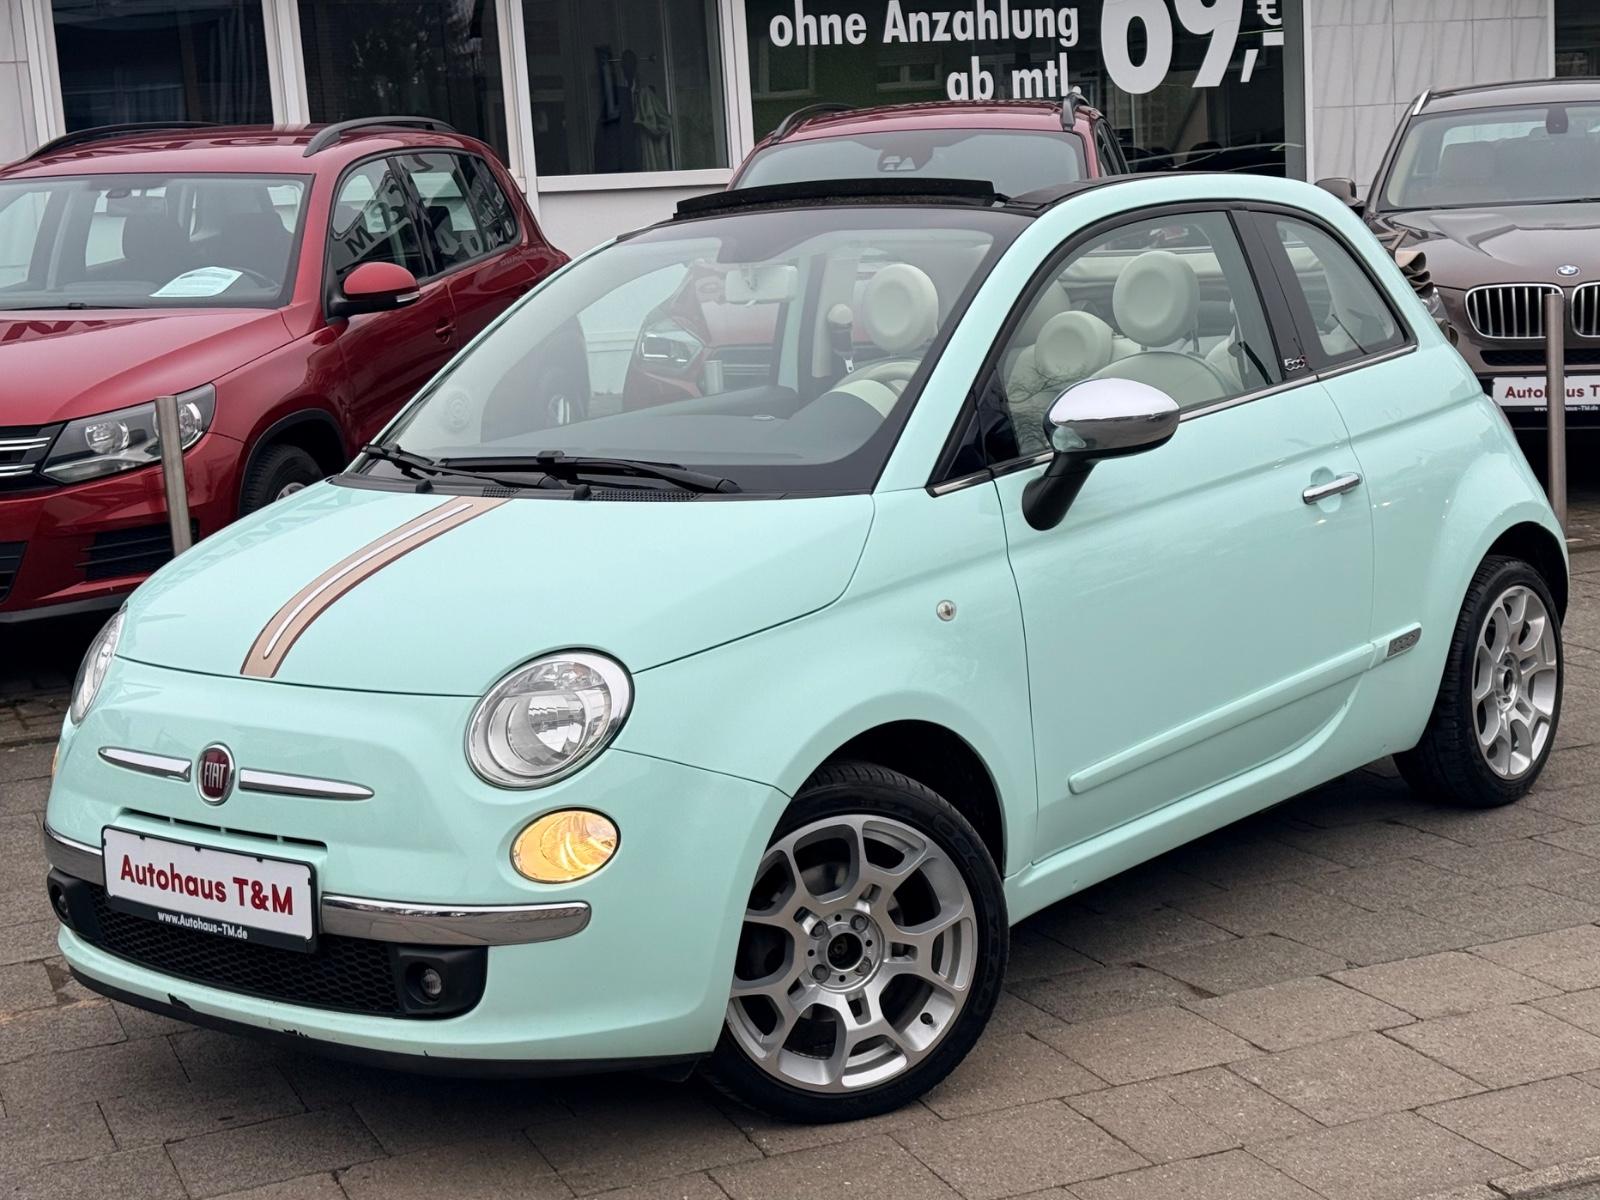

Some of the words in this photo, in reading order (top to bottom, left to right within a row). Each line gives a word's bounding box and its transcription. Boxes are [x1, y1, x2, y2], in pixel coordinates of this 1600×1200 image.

[769, 0, 867, 47] ohne
[882, 0, 1079, 48] Anzahlung
[946, 55, 995, 100] ab
[1011, 52, 1082, 99] mtl.
[1505, 384, 1585, 399] Autous
[203, 761, 227, 790] FIAT
[120, 854, 227, 903] Autohaus
[232, 876, 294, 915] T&M
[157, 912, 248, 940] www.Autohaus-TM.de
